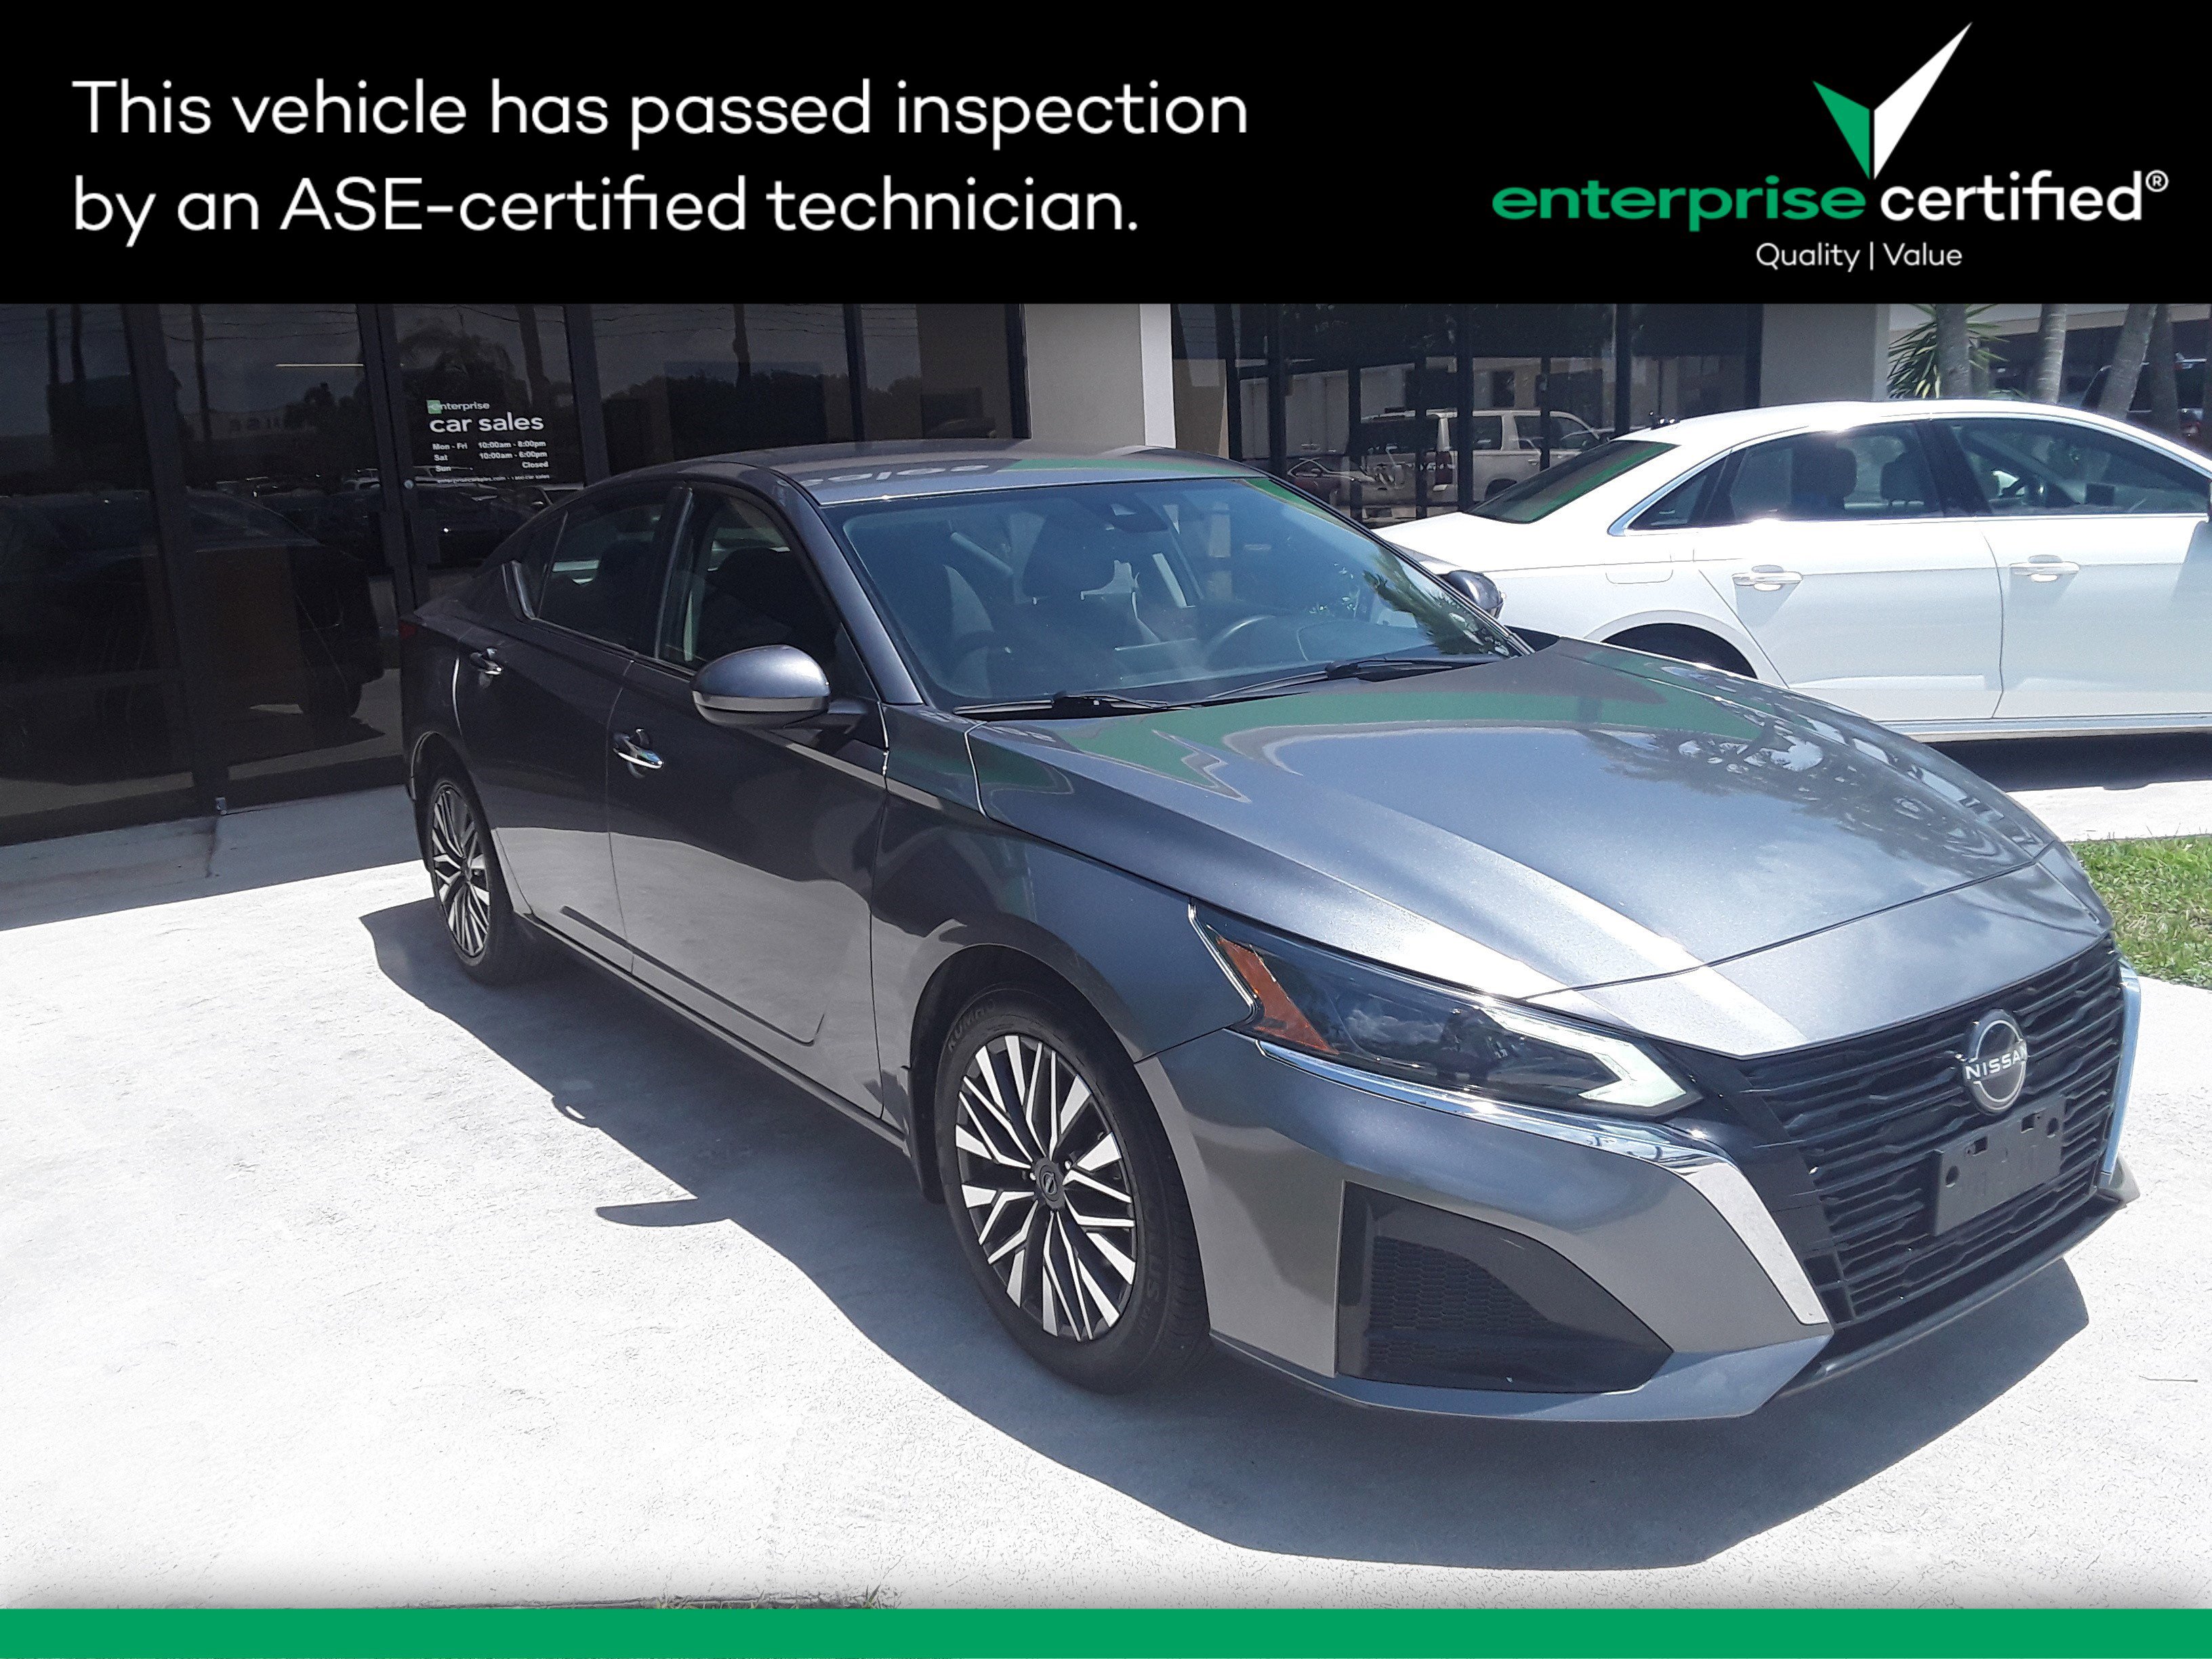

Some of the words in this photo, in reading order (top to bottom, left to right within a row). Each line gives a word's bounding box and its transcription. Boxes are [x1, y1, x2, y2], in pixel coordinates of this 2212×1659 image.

[430, 418, 472, 432] car
[478, 411, 544, 432] sales
[1965, 1047, 2028, 1081] NISSAN
